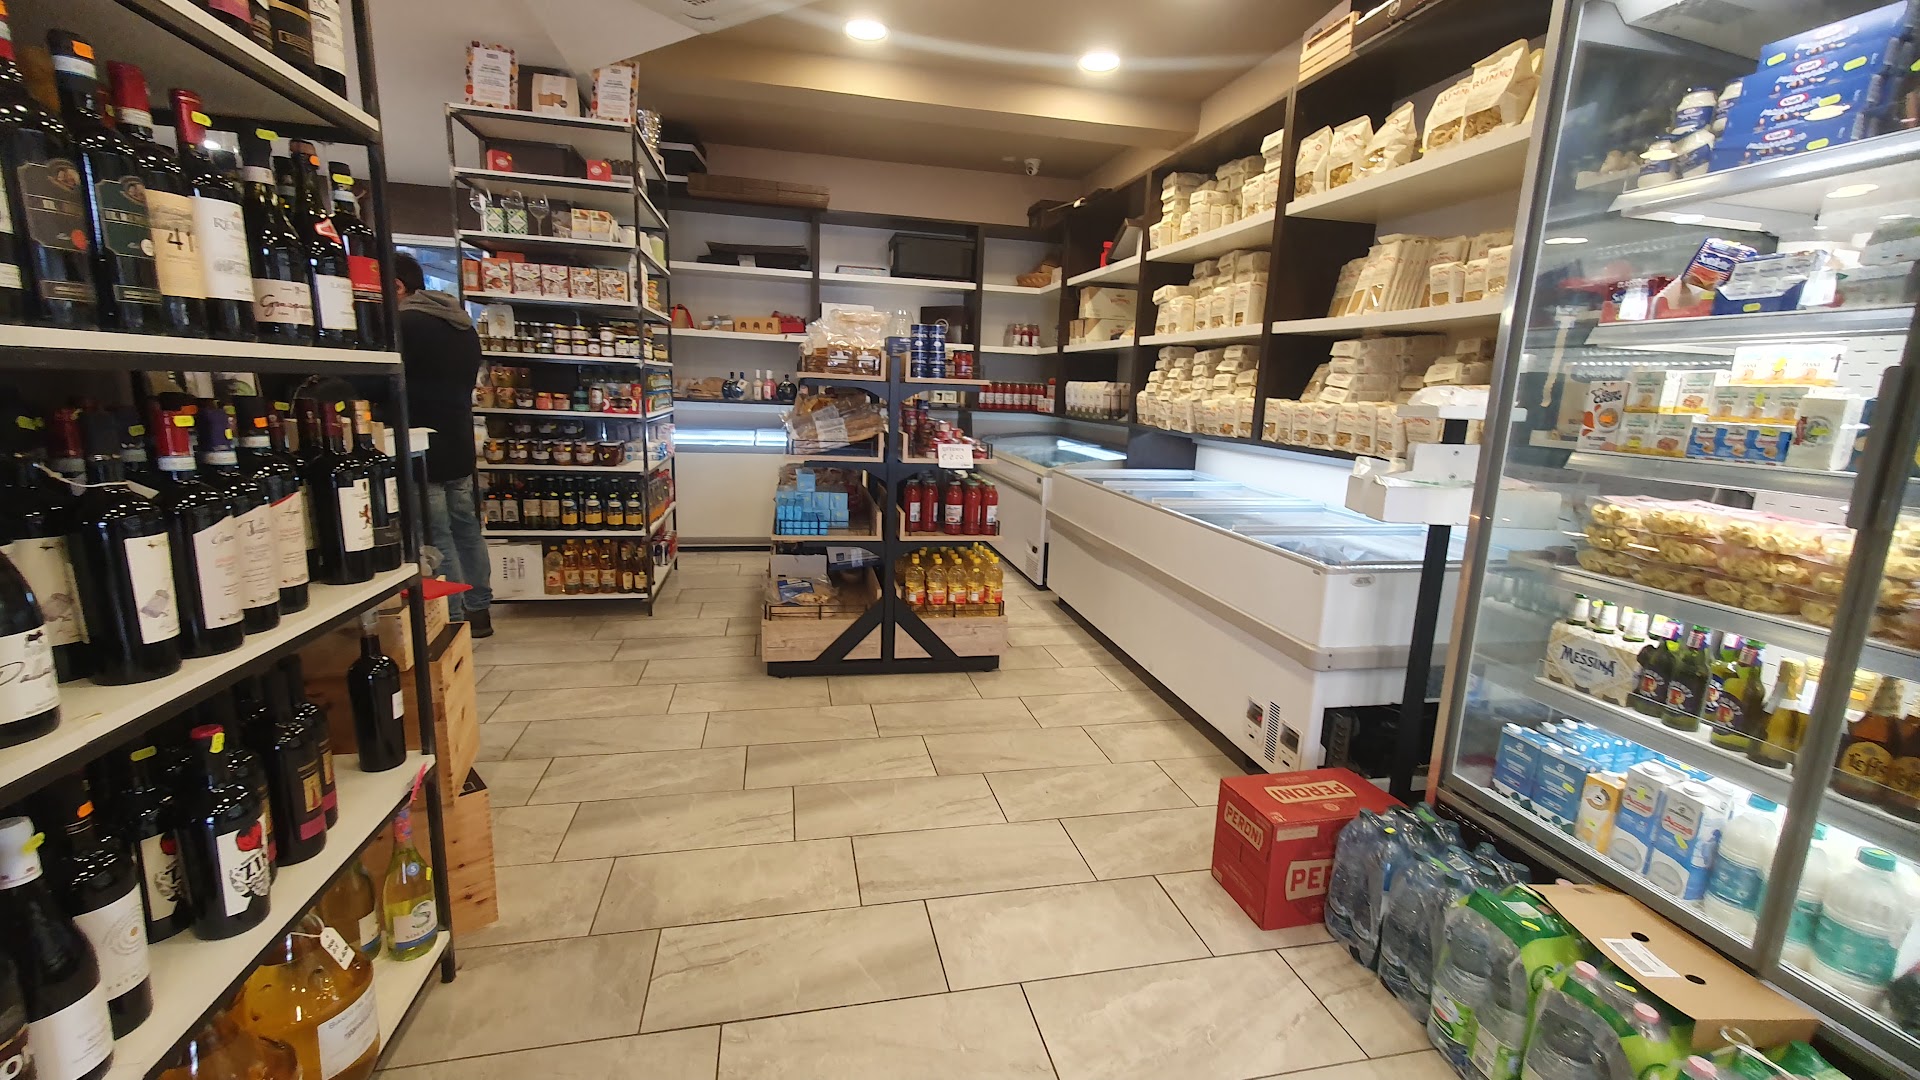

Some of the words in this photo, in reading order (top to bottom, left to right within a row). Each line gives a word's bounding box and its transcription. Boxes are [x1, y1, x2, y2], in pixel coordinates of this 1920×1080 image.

[167, 227, 194, 252] 41
[1560, 644, 1617, 677] MESSINA
[1270, 783, 1349, 800] PERONI
[1226, 805, 1263, 848] PERONI
